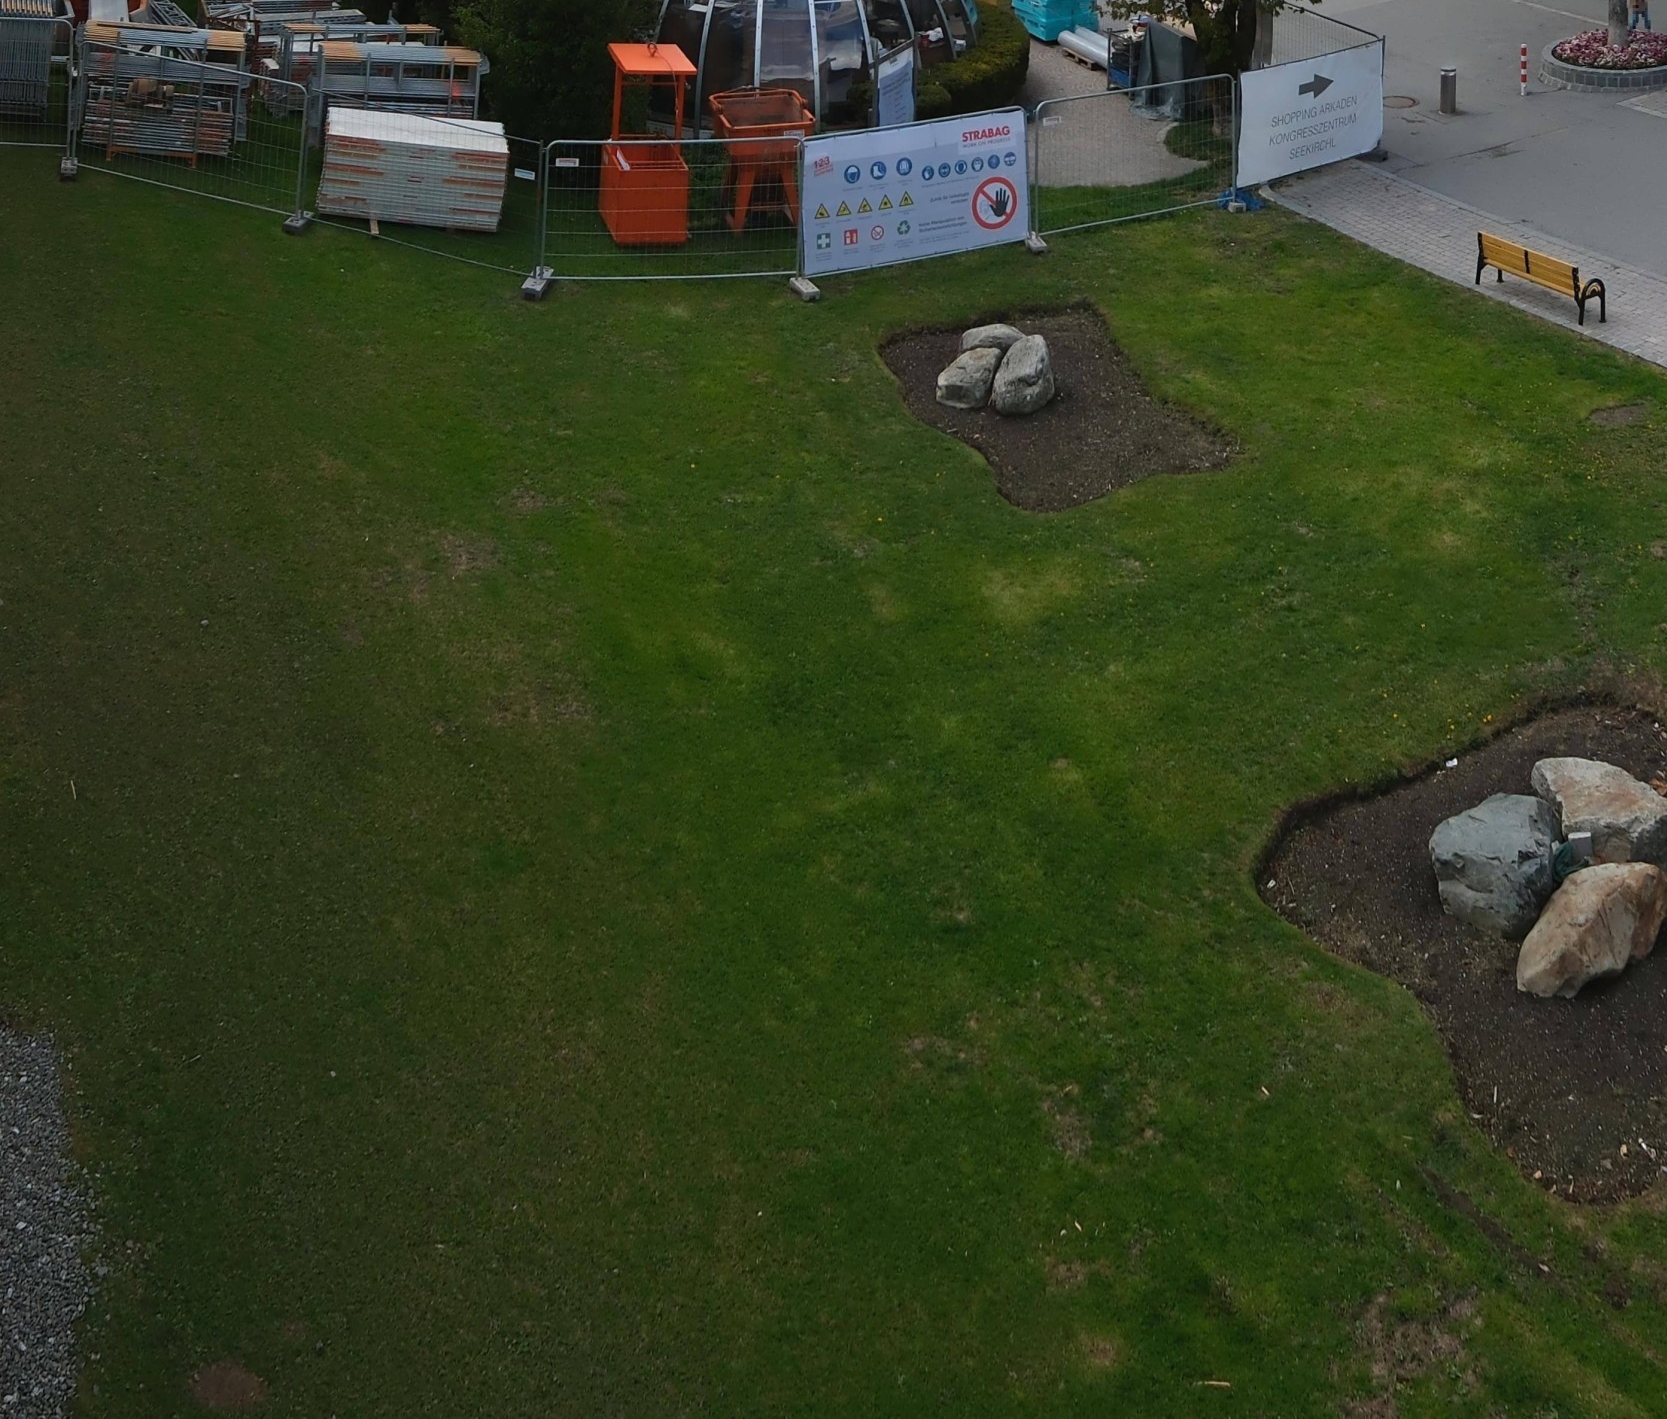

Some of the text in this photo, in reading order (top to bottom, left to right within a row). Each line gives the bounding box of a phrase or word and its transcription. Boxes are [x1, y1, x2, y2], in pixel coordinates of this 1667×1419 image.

[1271, 95, 1358, 128] SHOPPING ARKADEN
[962, 125, 1011, 143] STRABAG
[1269, 112, 1358, 147] KONGRESSZENTRUM
[1289, 138, 1337, 160] SEEKIRCHL
